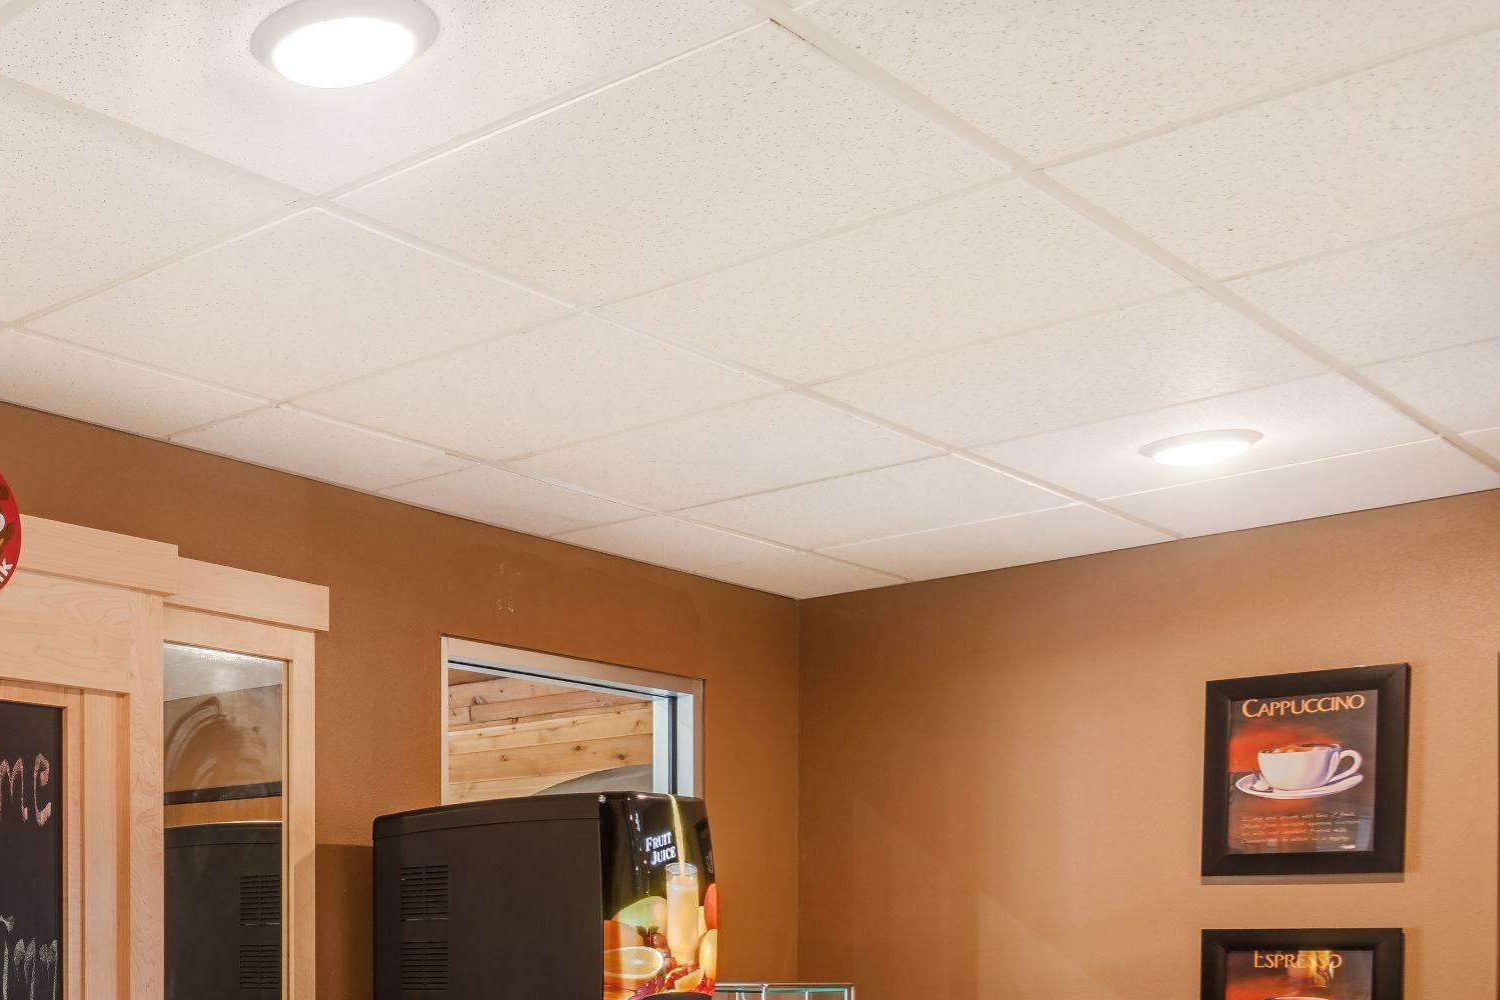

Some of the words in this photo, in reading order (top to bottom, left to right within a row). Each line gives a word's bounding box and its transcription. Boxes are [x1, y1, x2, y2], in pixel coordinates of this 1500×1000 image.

[1242, 693, 1366, 718] CAPPUCCINO
[645, 831, 672, 852] FRUIT
[650, 846, 677, 865] JUICE
